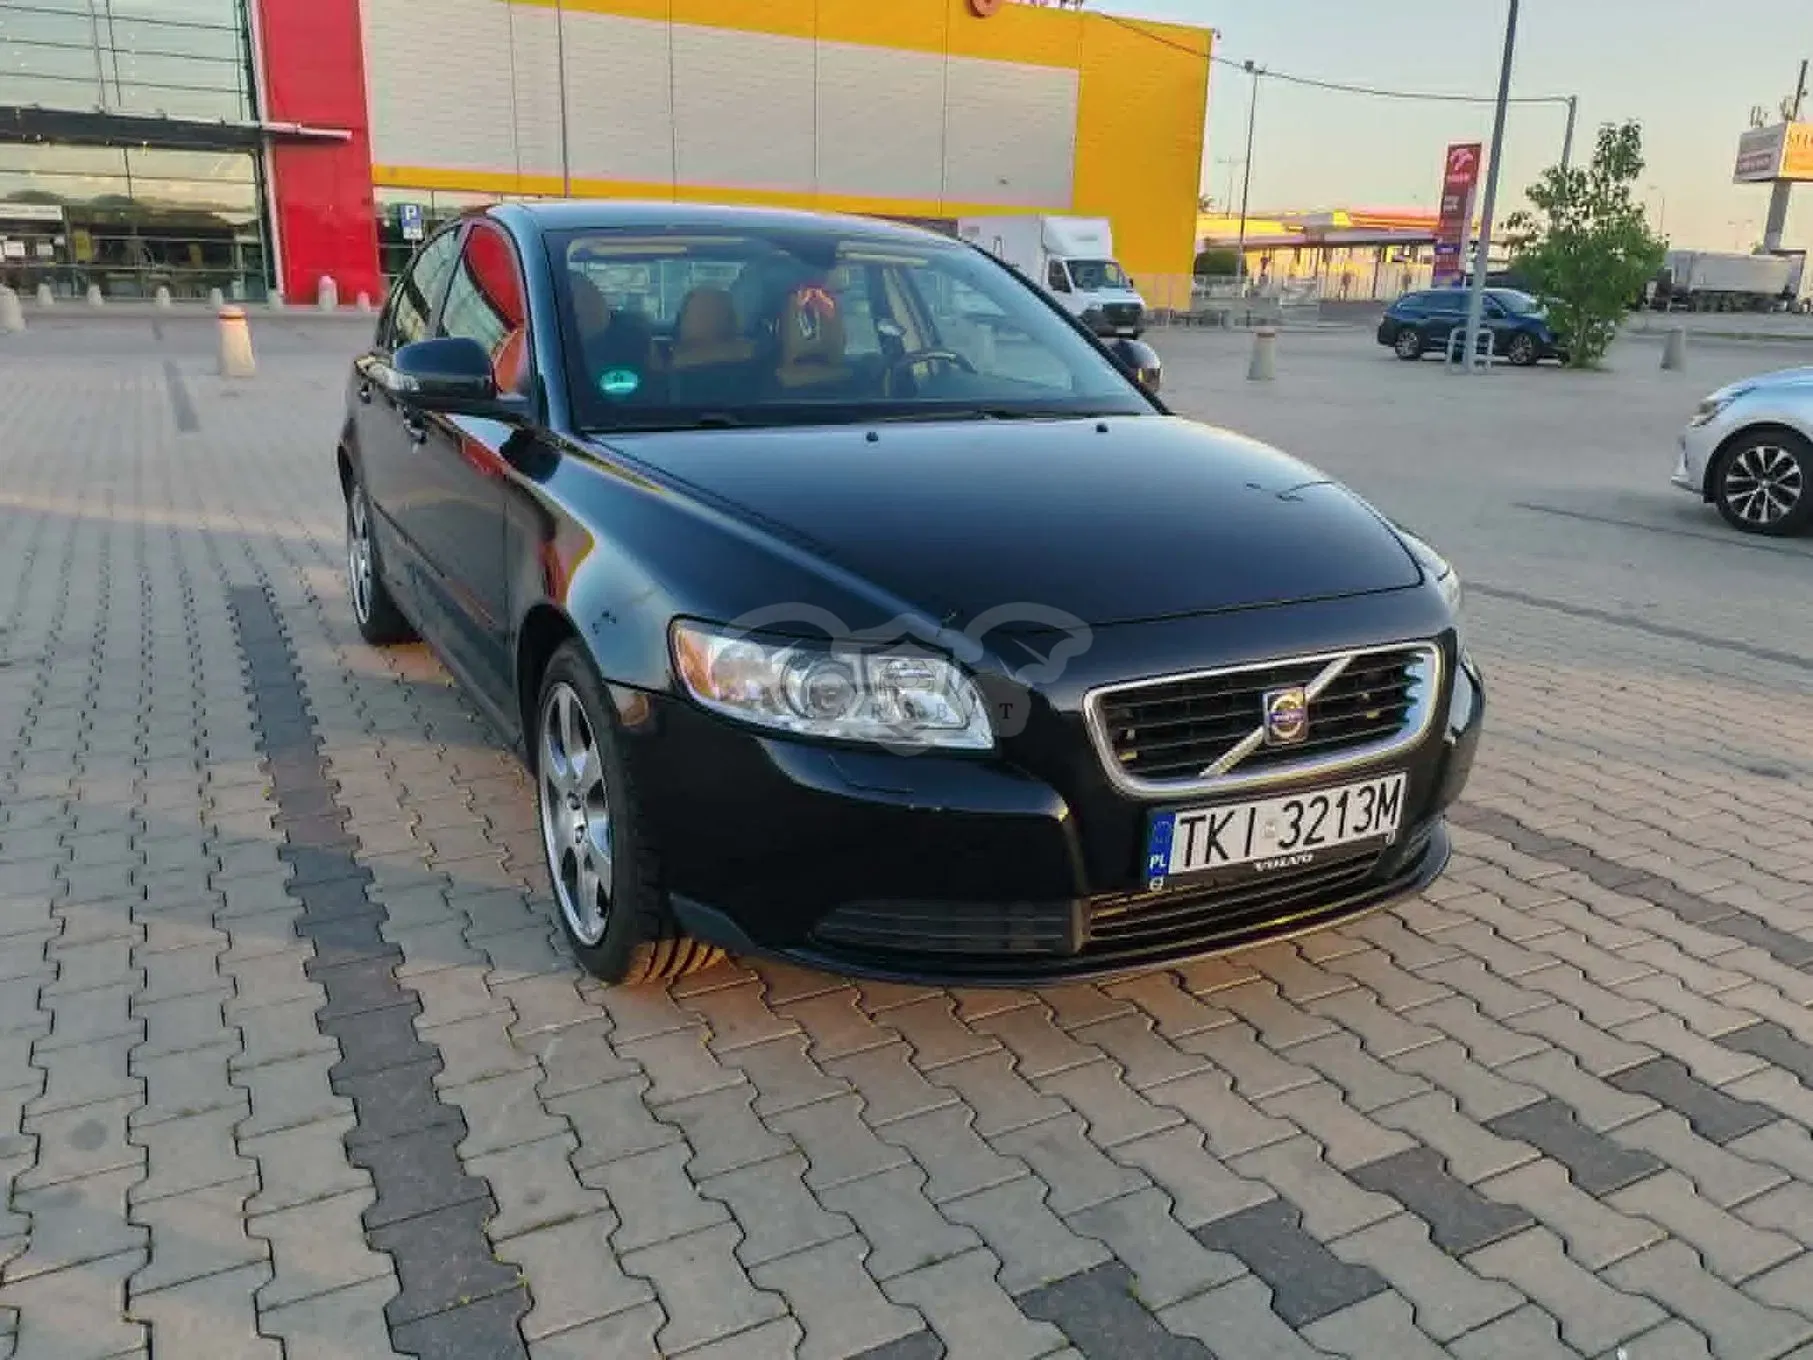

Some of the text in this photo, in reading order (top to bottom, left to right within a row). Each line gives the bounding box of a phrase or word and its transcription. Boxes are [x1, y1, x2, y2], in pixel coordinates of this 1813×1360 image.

[1179, 778, 1402, 867] TKI 3213M
[1149, 854, 1167, 870] PL
